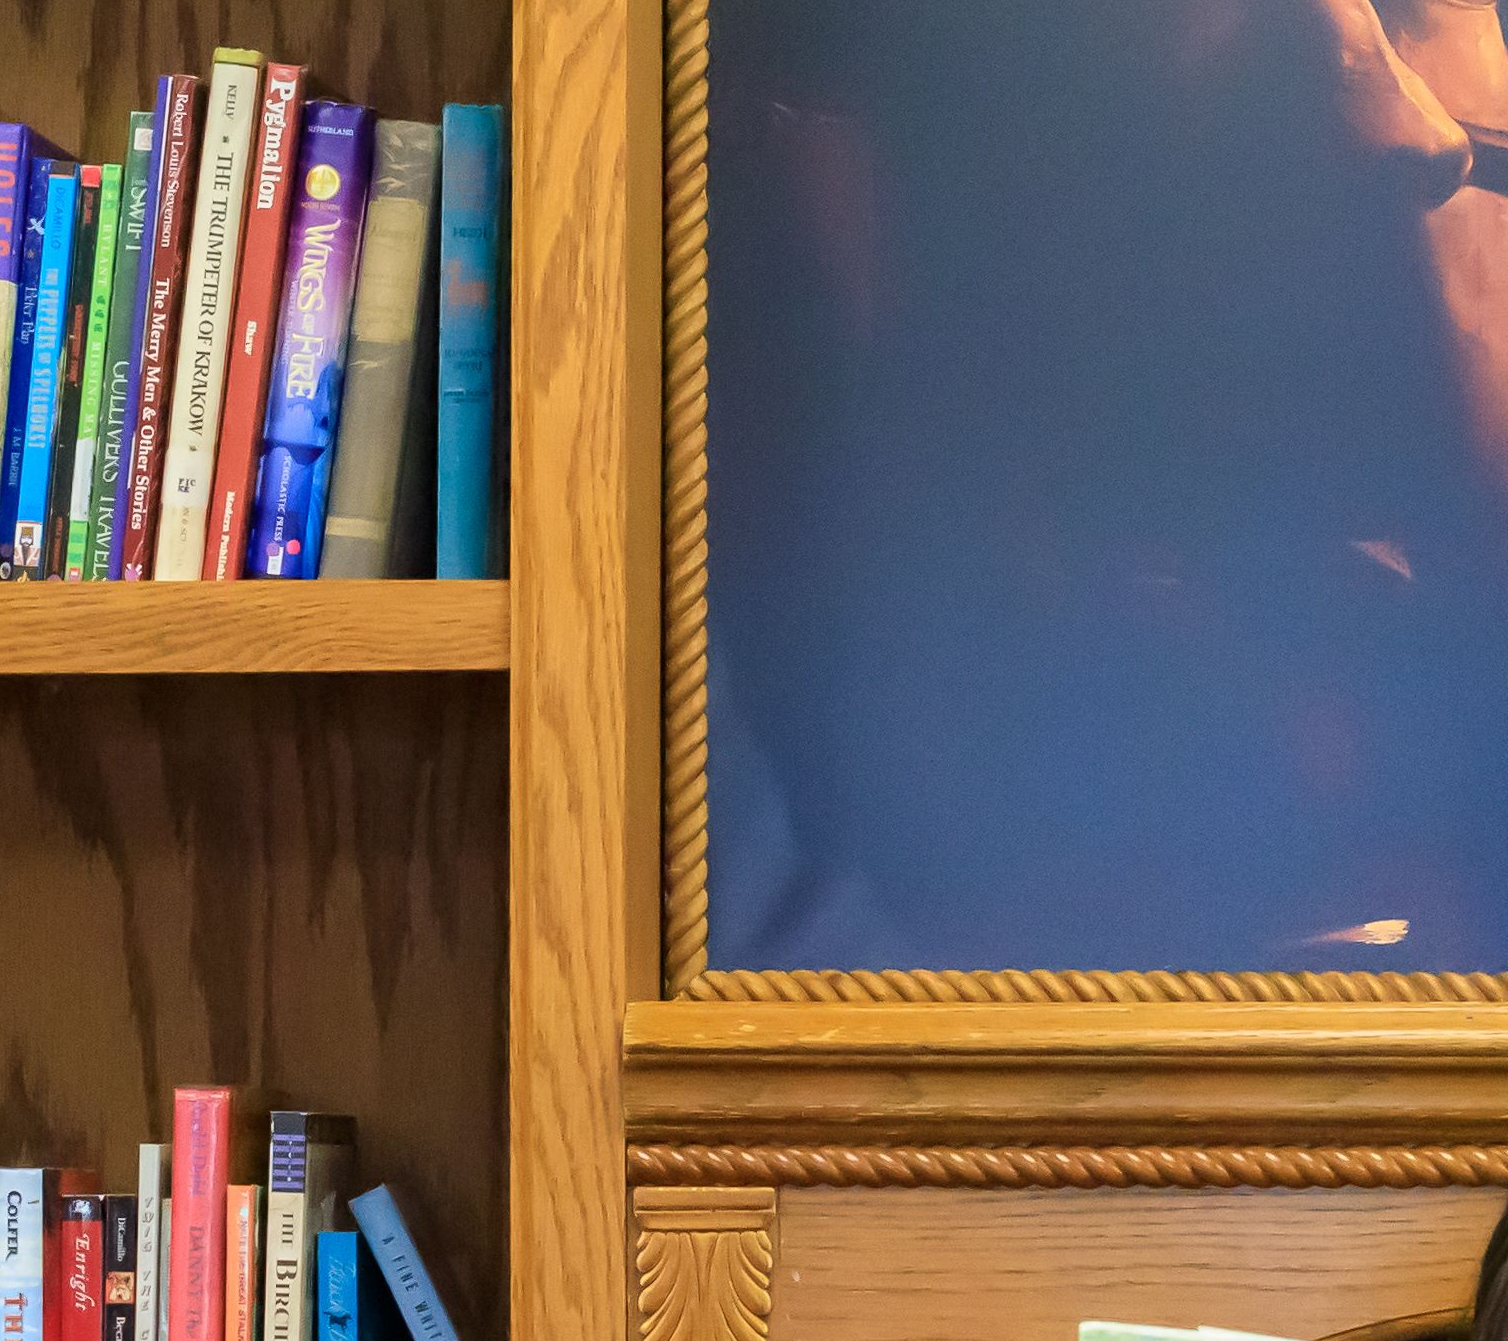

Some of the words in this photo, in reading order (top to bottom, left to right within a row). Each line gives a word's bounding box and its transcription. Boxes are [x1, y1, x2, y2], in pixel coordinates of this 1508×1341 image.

[213, 152, 234, 191] THE
[256, 78, 297, 210] Pygmalion
[197, 197, 230, 315] TRUMPETER
[297, 218, 341, 312] WINGS
[197, 319, 217, 346] OF
[285, 332, 325, 400] FIRE
[185, 350, 213, 436] KRAKOW
[5, 1191, 23, 1260] COLFER
[71, 1233, 95, 1311] Enright
